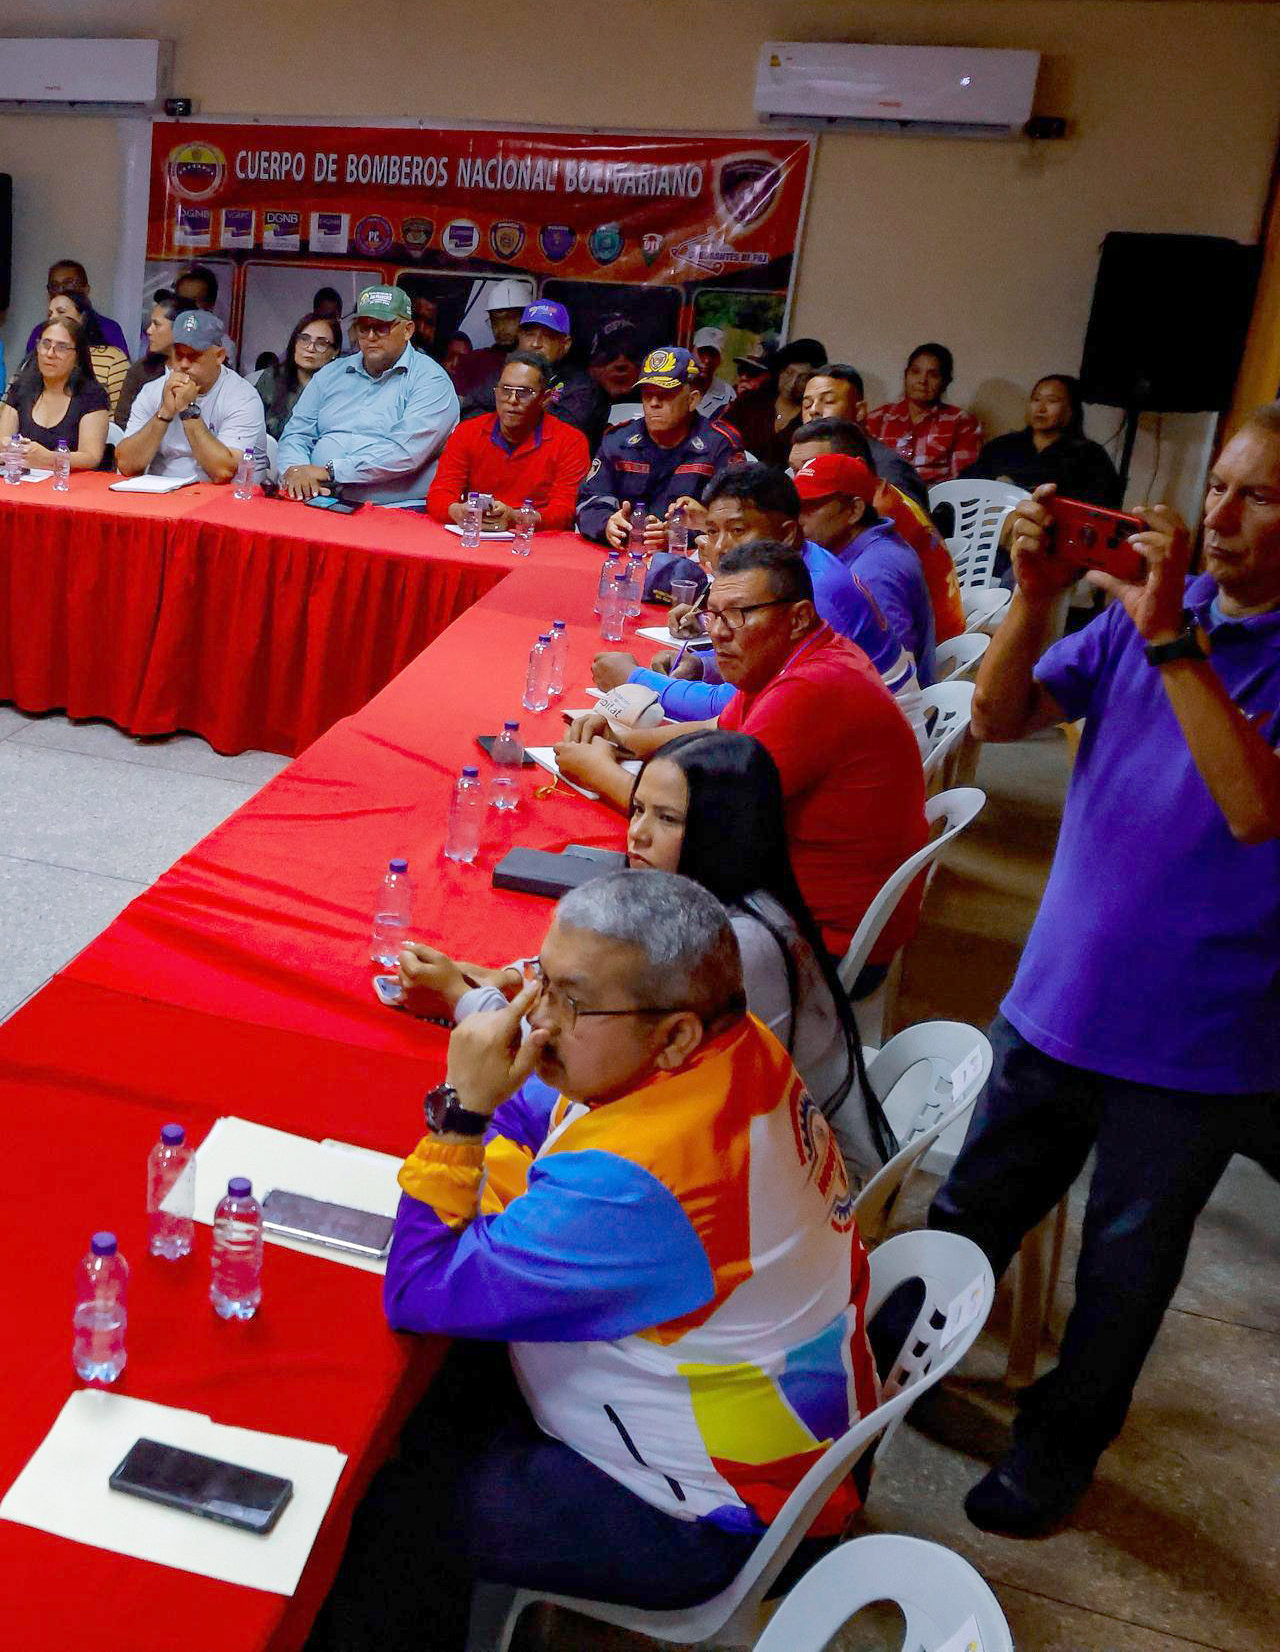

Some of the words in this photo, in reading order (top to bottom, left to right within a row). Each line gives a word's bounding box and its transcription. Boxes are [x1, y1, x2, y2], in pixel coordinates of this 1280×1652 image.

[234, 150, 306, 182] CUERPO
[313, 152, 338, 182] DE
[345, 153, 449, 187] BOMBEROS
[456, 156, 557, 192] NACIONAL
[564, 159, 704, 197] BOLIVARIANO
[266, 212, 299, 224] DGNB
